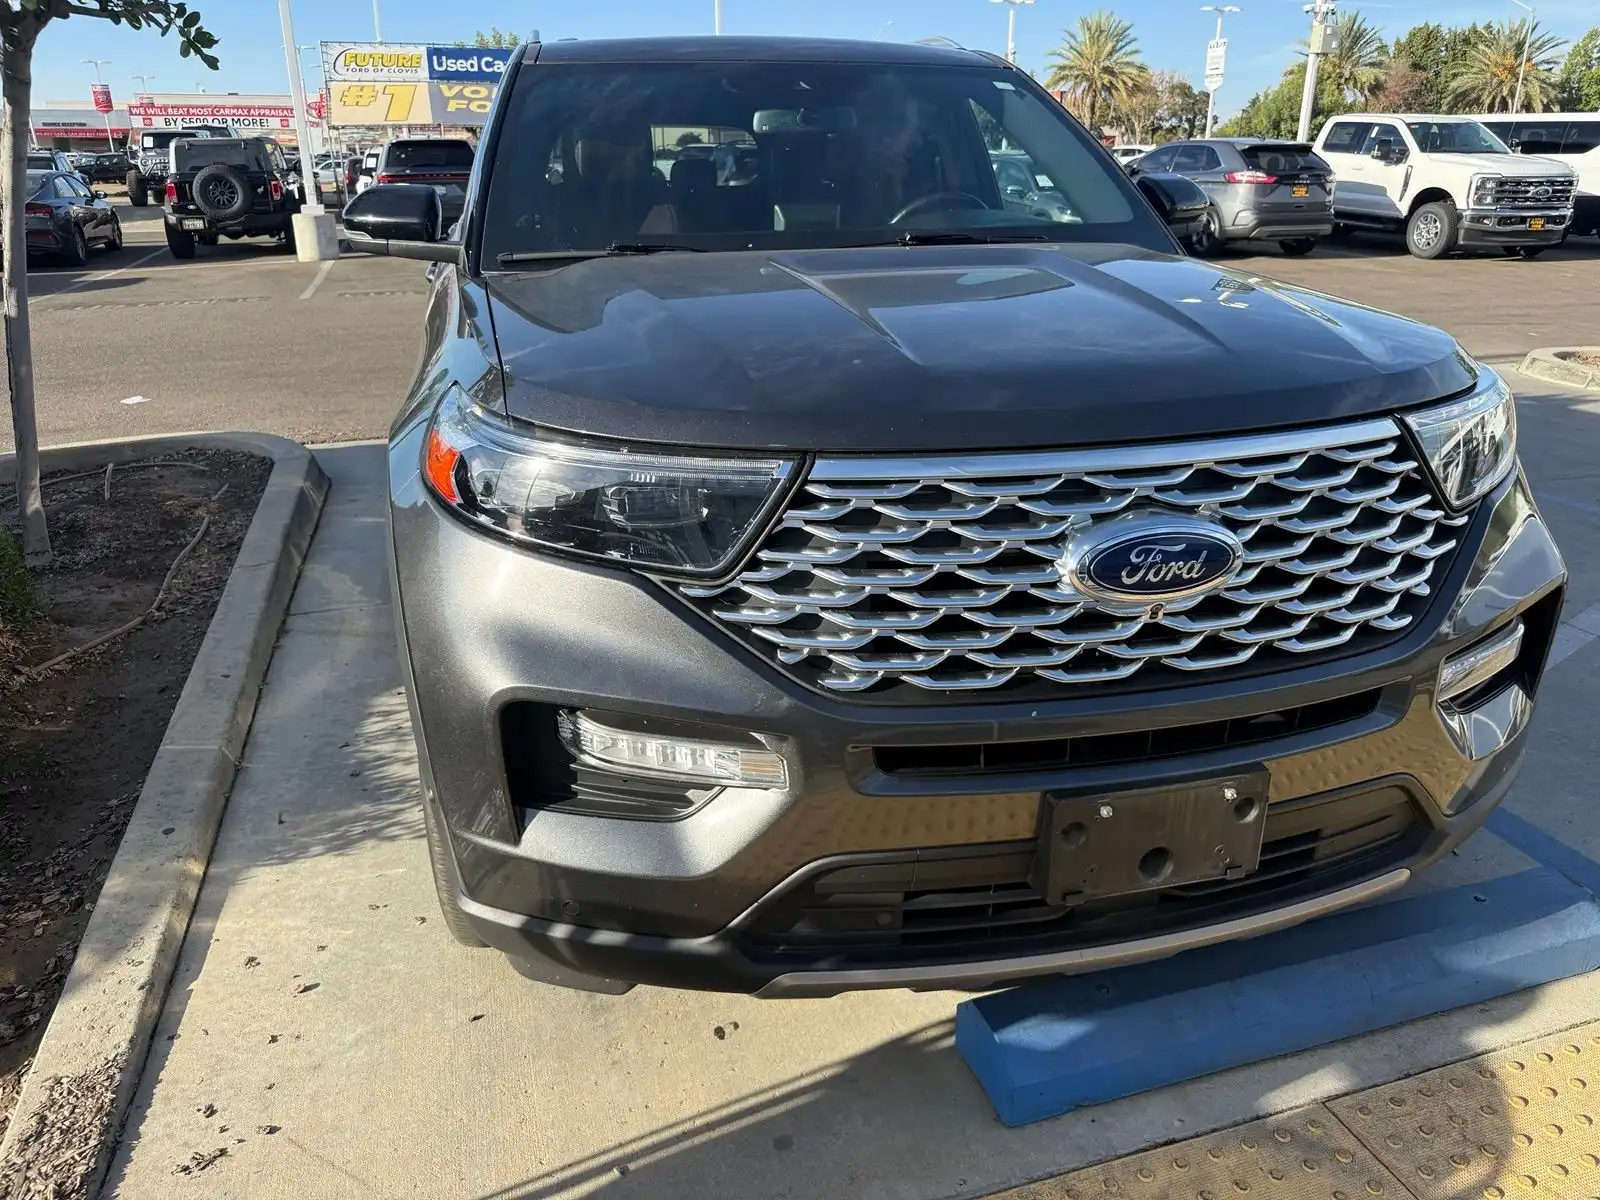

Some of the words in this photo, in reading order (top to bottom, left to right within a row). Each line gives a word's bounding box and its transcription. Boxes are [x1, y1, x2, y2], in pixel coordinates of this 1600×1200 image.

[344, 53, 421, 67] FUTURE
[433, 55, 478, 73] Used
[480, 56, 505, 73] Ca
[340, 84, 418, 122] #1
[447, 100, 491, 112] FO
[131, 107, 145, 115] WE
[146, 107, 167, 115] WILL
[168, 107, 188, 115] BEAT
[189, 107, 212, 115] MOST
[213, 108, 248, 116] CARMAX
[164, 117, 178, 127] BY
[231, 117, 270, 127] MORE!
[1121, 543, 1208, 585] Ford
